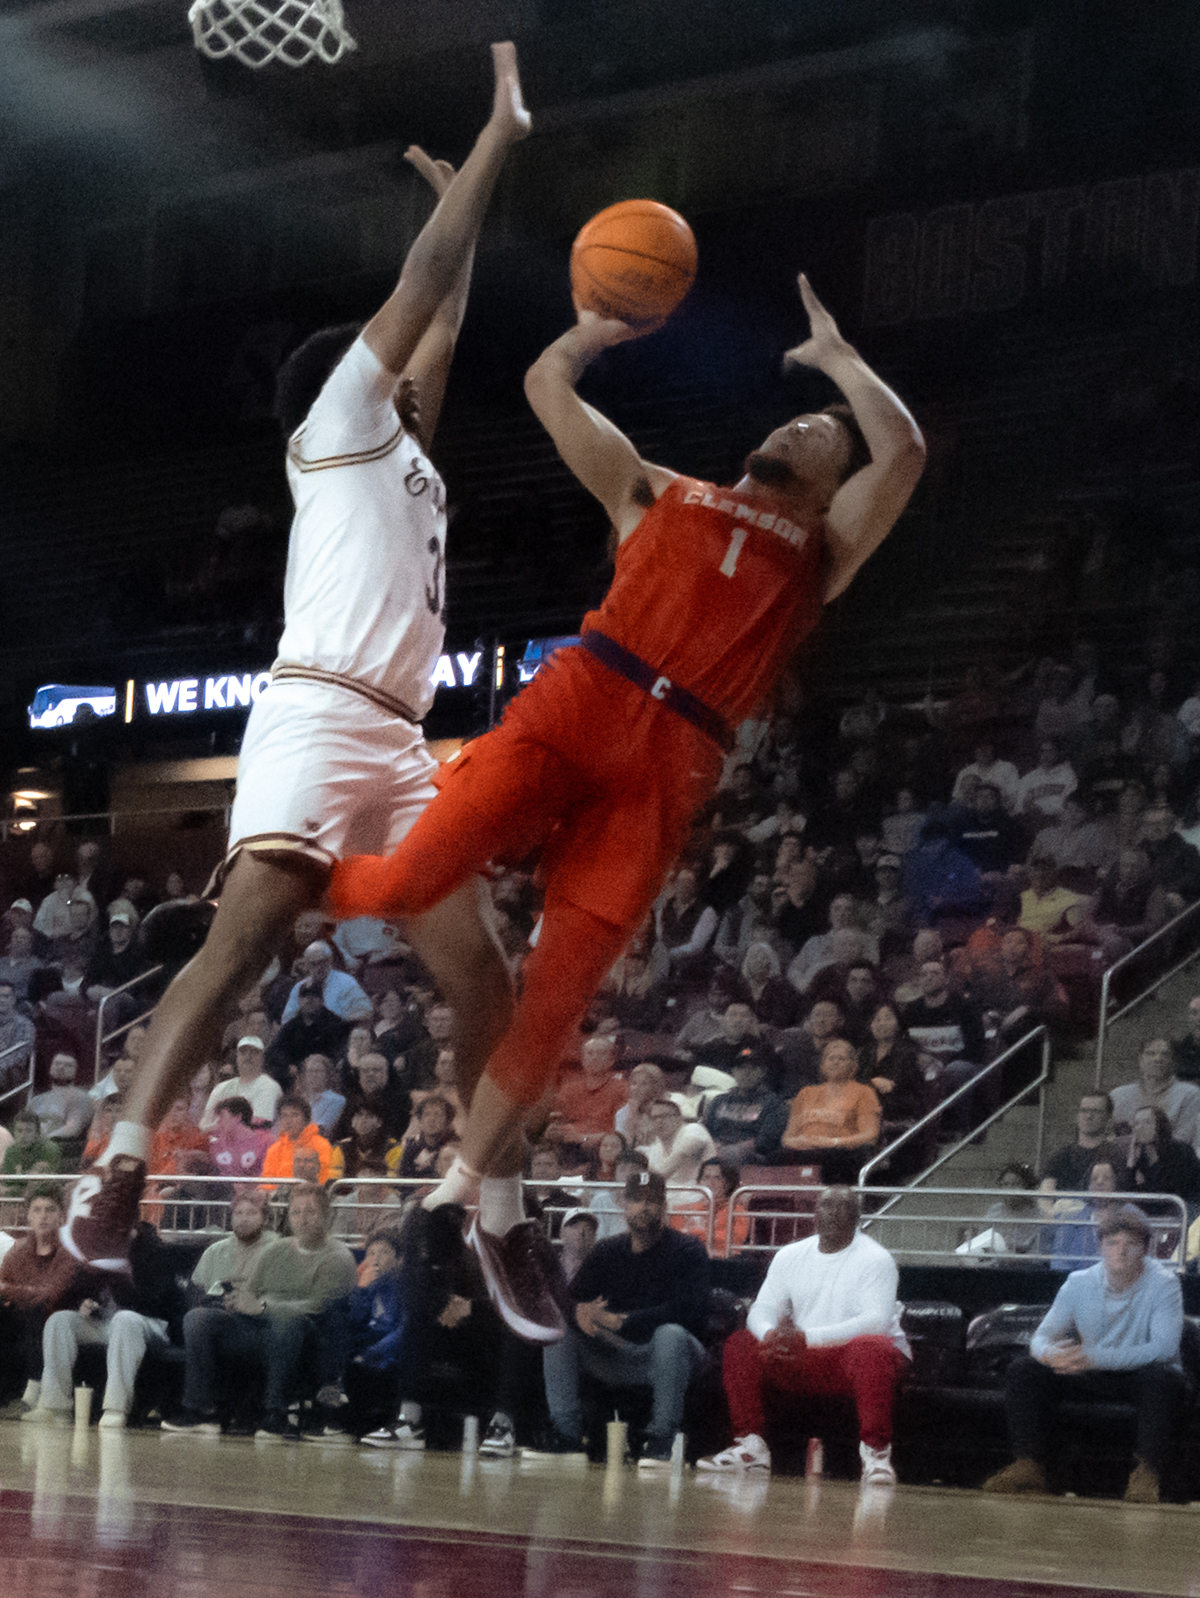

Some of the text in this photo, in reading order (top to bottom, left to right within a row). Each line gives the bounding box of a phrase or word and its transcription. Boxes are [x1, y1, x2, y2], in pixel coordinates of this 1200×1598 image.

[683, 490, 809, 550] CLEMSON
[719, 527, 748, 578] 1
[146, 679, 199, 714] WE
[650, 676, 672, 700] C
